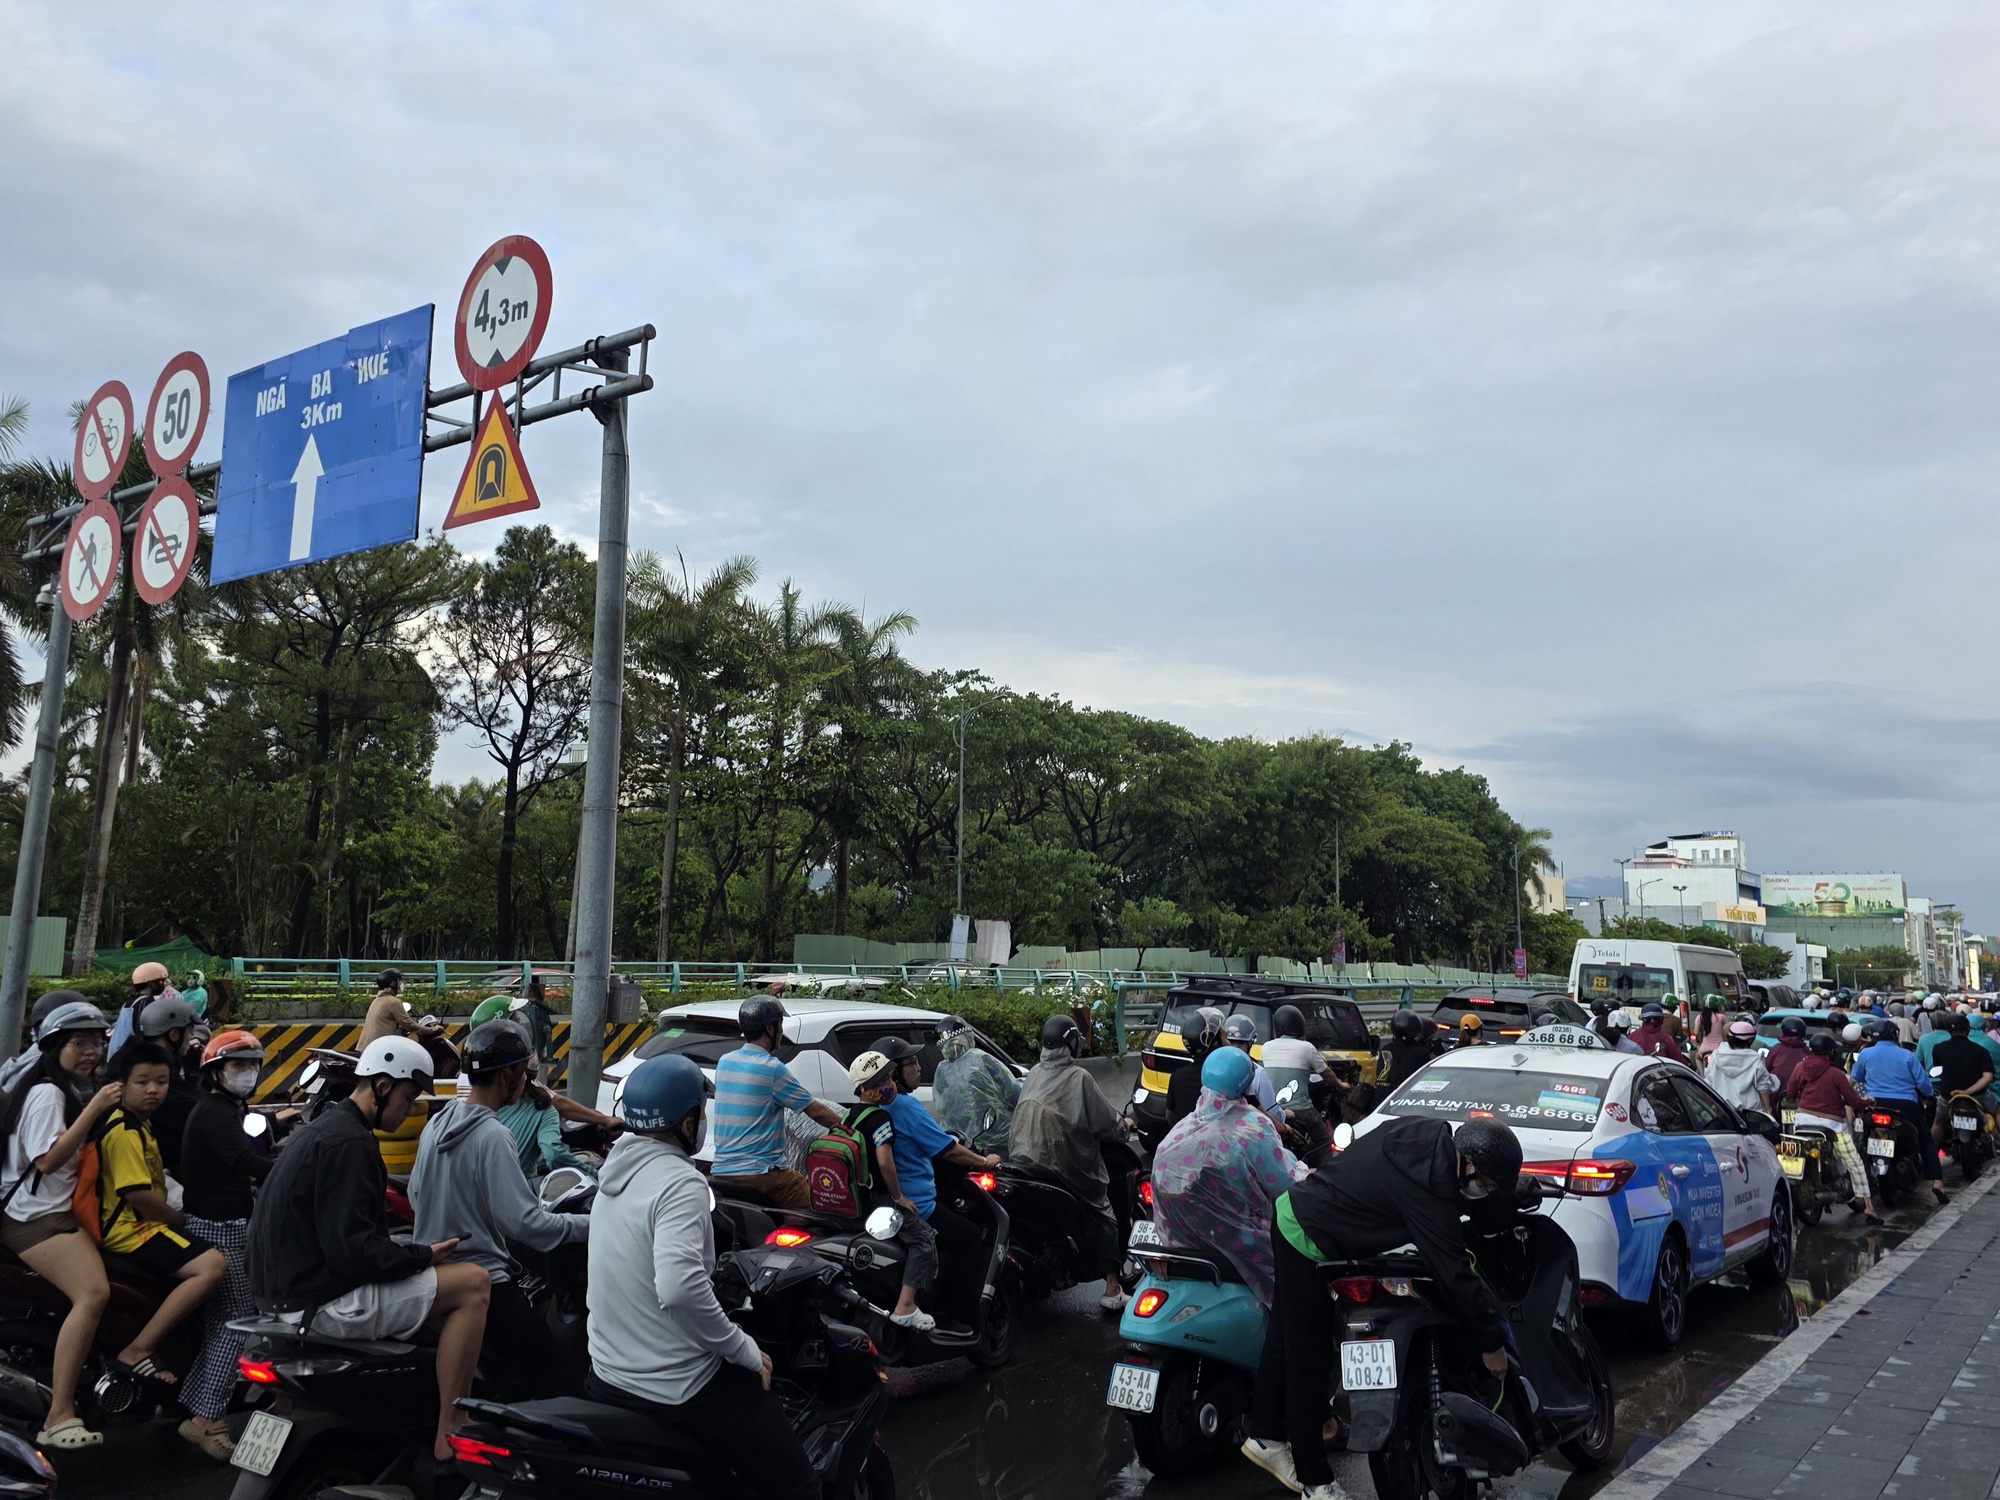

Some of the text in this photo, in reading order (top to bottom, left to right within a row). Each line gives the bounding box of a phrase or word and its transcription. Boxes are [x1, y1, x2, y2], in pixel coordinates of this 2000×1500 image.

[474, 288, 529, 341] 4,3m
[256, 340, 391, 417] NGÃ BA HUẾ
[162, 387, 191, 445] 50
[300, 401, 342, 429] 3Km
[1814, 882, 1851, 901] 50
[1597, 949, 1620, 958] Telala
[1528, 1033, 1594, 1045] 3.68 68 68
[1552, 1026, 1572, 1034] (0236)
[1554, 1084, 1587, 1095] 5495
[1389, 1099, 1597, 1124] VINASUN TAXI 3.68 68 68
[1687, 1184, 1721, 1201] MUA INVERTER
[1704, 1202, 1722, 1218] MIDEA
[1350, 1343, 1385, 1364] 43-D1
[1119, 1368, 1151, 1390] 43-AA
[1346, 1365, 1393, 1387] 408.21
[1110, 1385, 1152, 1409] 086.29
[252, 1416, 285, 1445] 43-K1
[236, 1440, 278, 1471] 370.52
[575, 1466, 673, 1490] AIRBLADE
